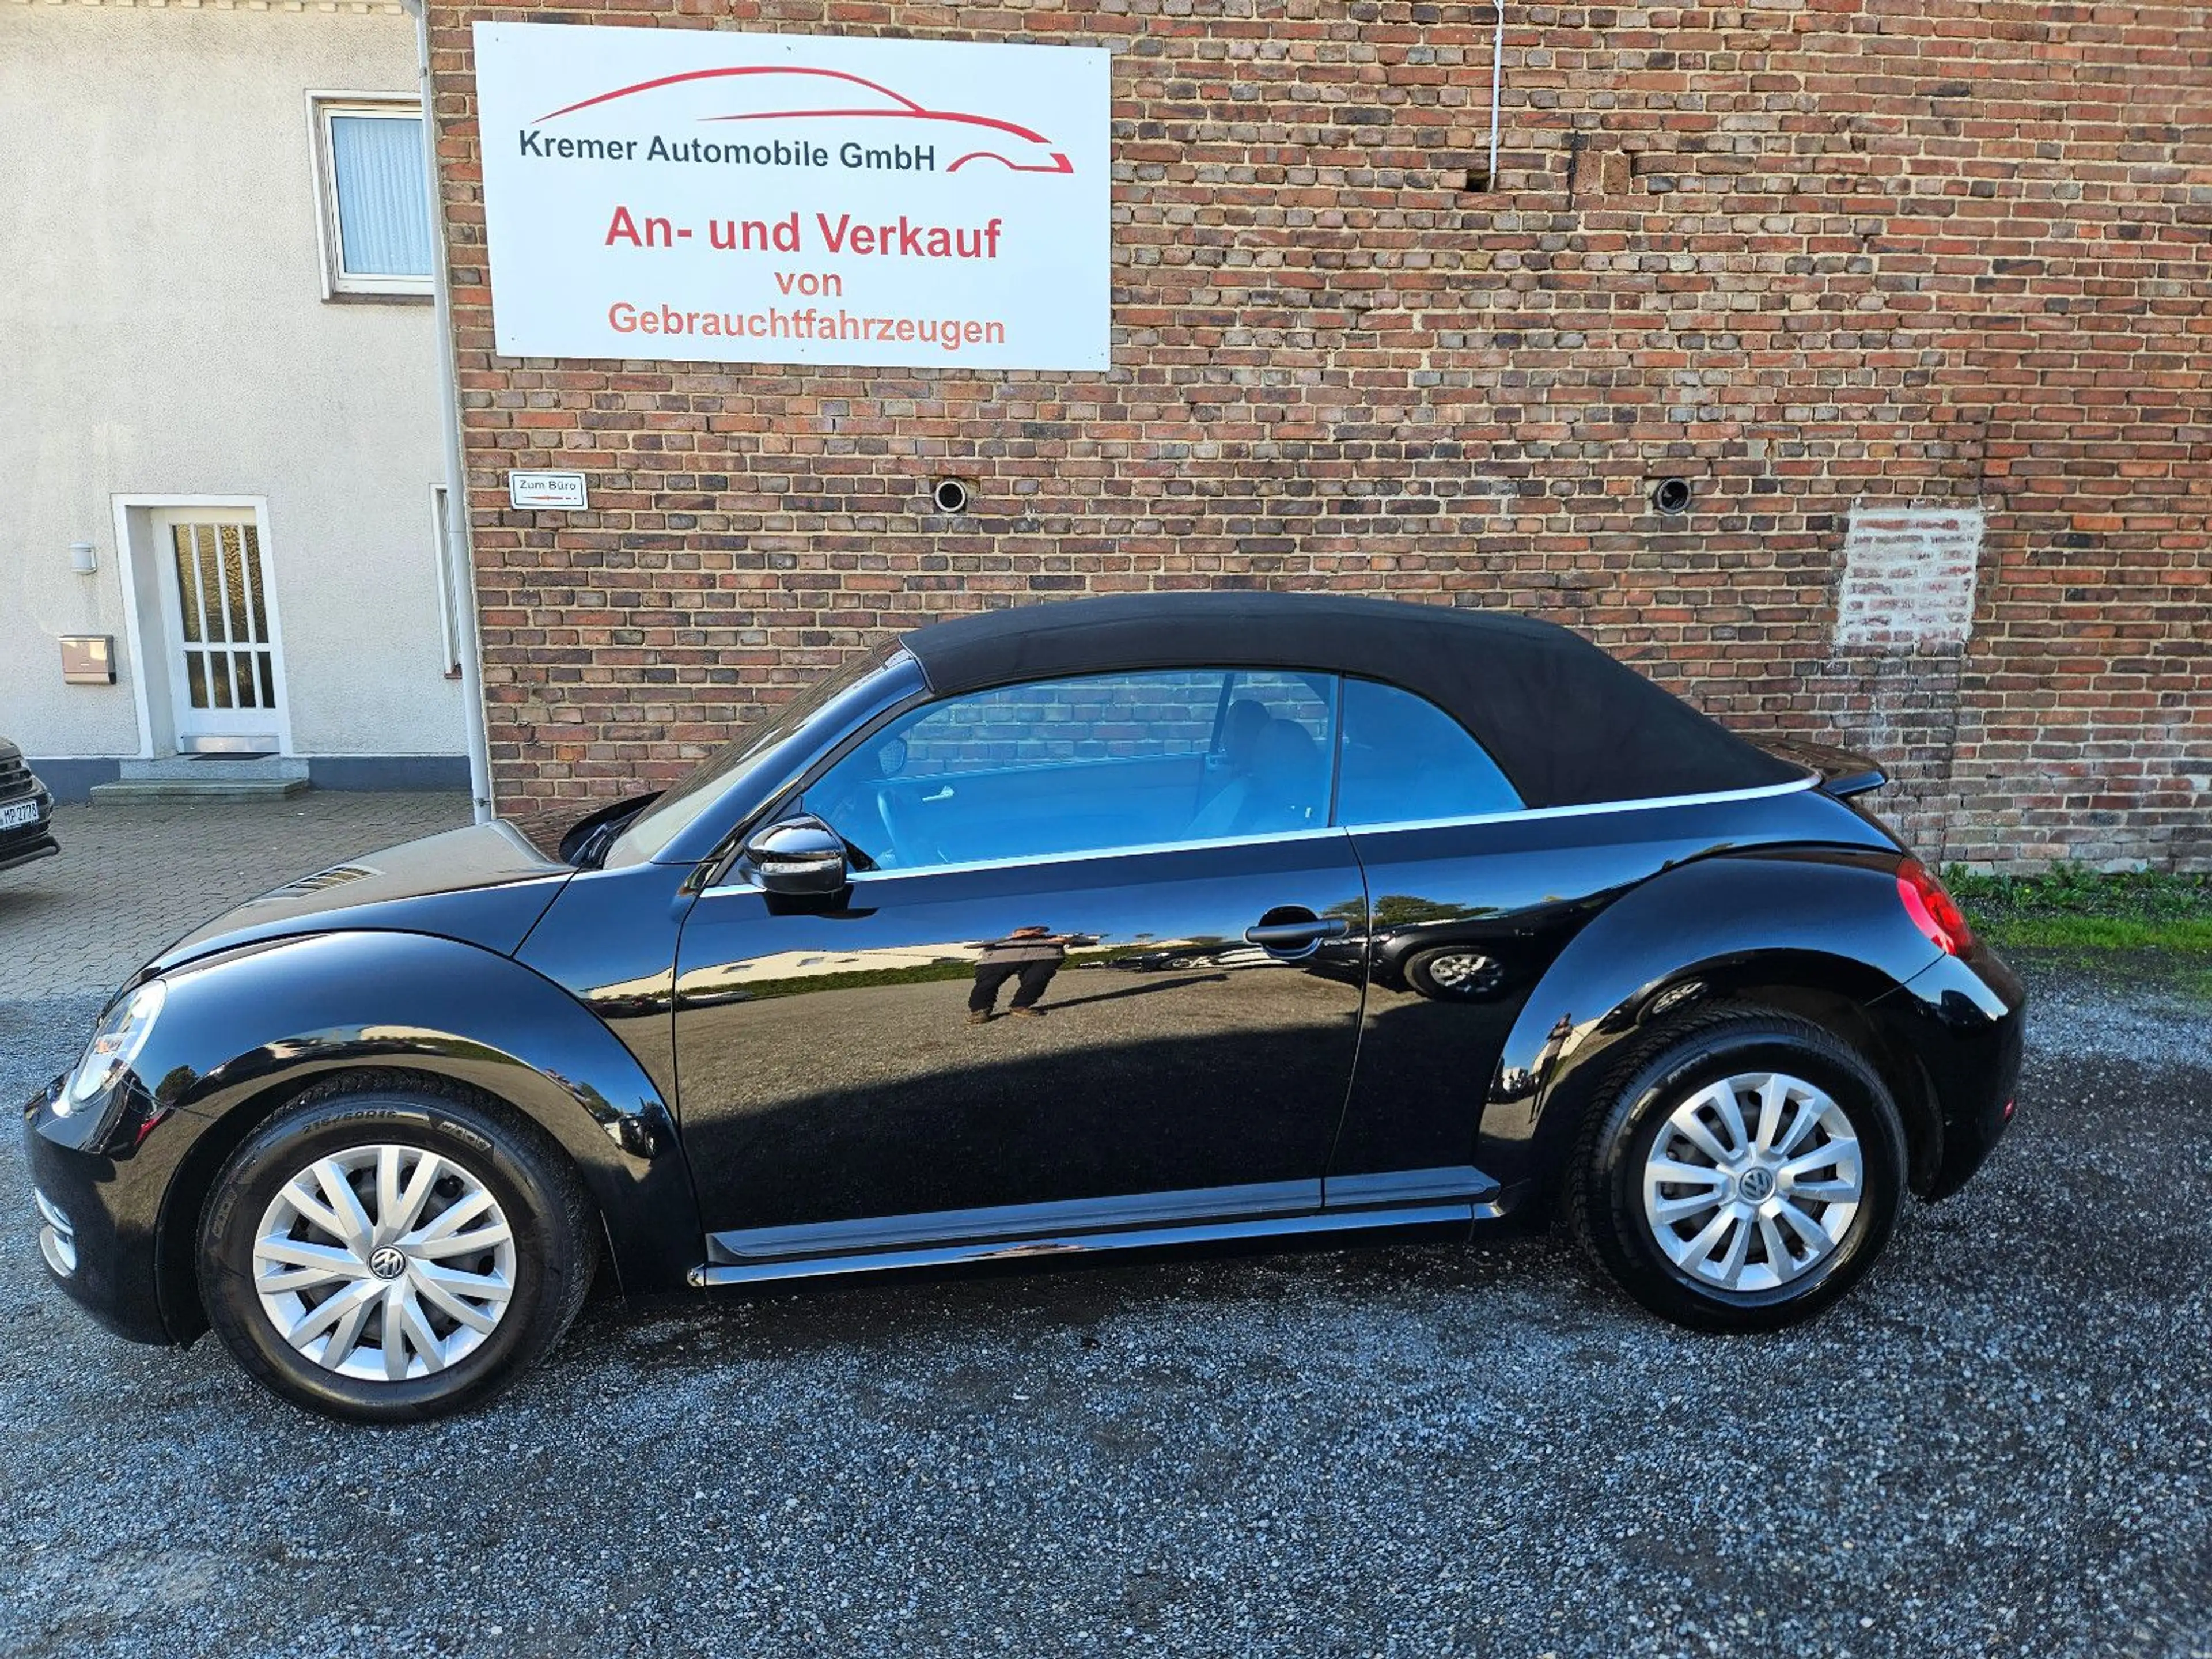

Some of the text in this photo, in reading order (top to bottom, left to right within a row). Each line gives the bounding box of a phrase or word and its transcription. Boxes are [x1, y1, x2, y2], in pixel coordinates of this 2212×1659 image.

[519, 129, 934, 171] Kremer Automobile GmbH
[604, 206, 1002, 259] An- und Verkauf
[774, 272, 842, 297] von
[608, 302, 1005, 351] Gebrauchtfahrzeugen
[520, 479, 576, 490] Zum Büro
